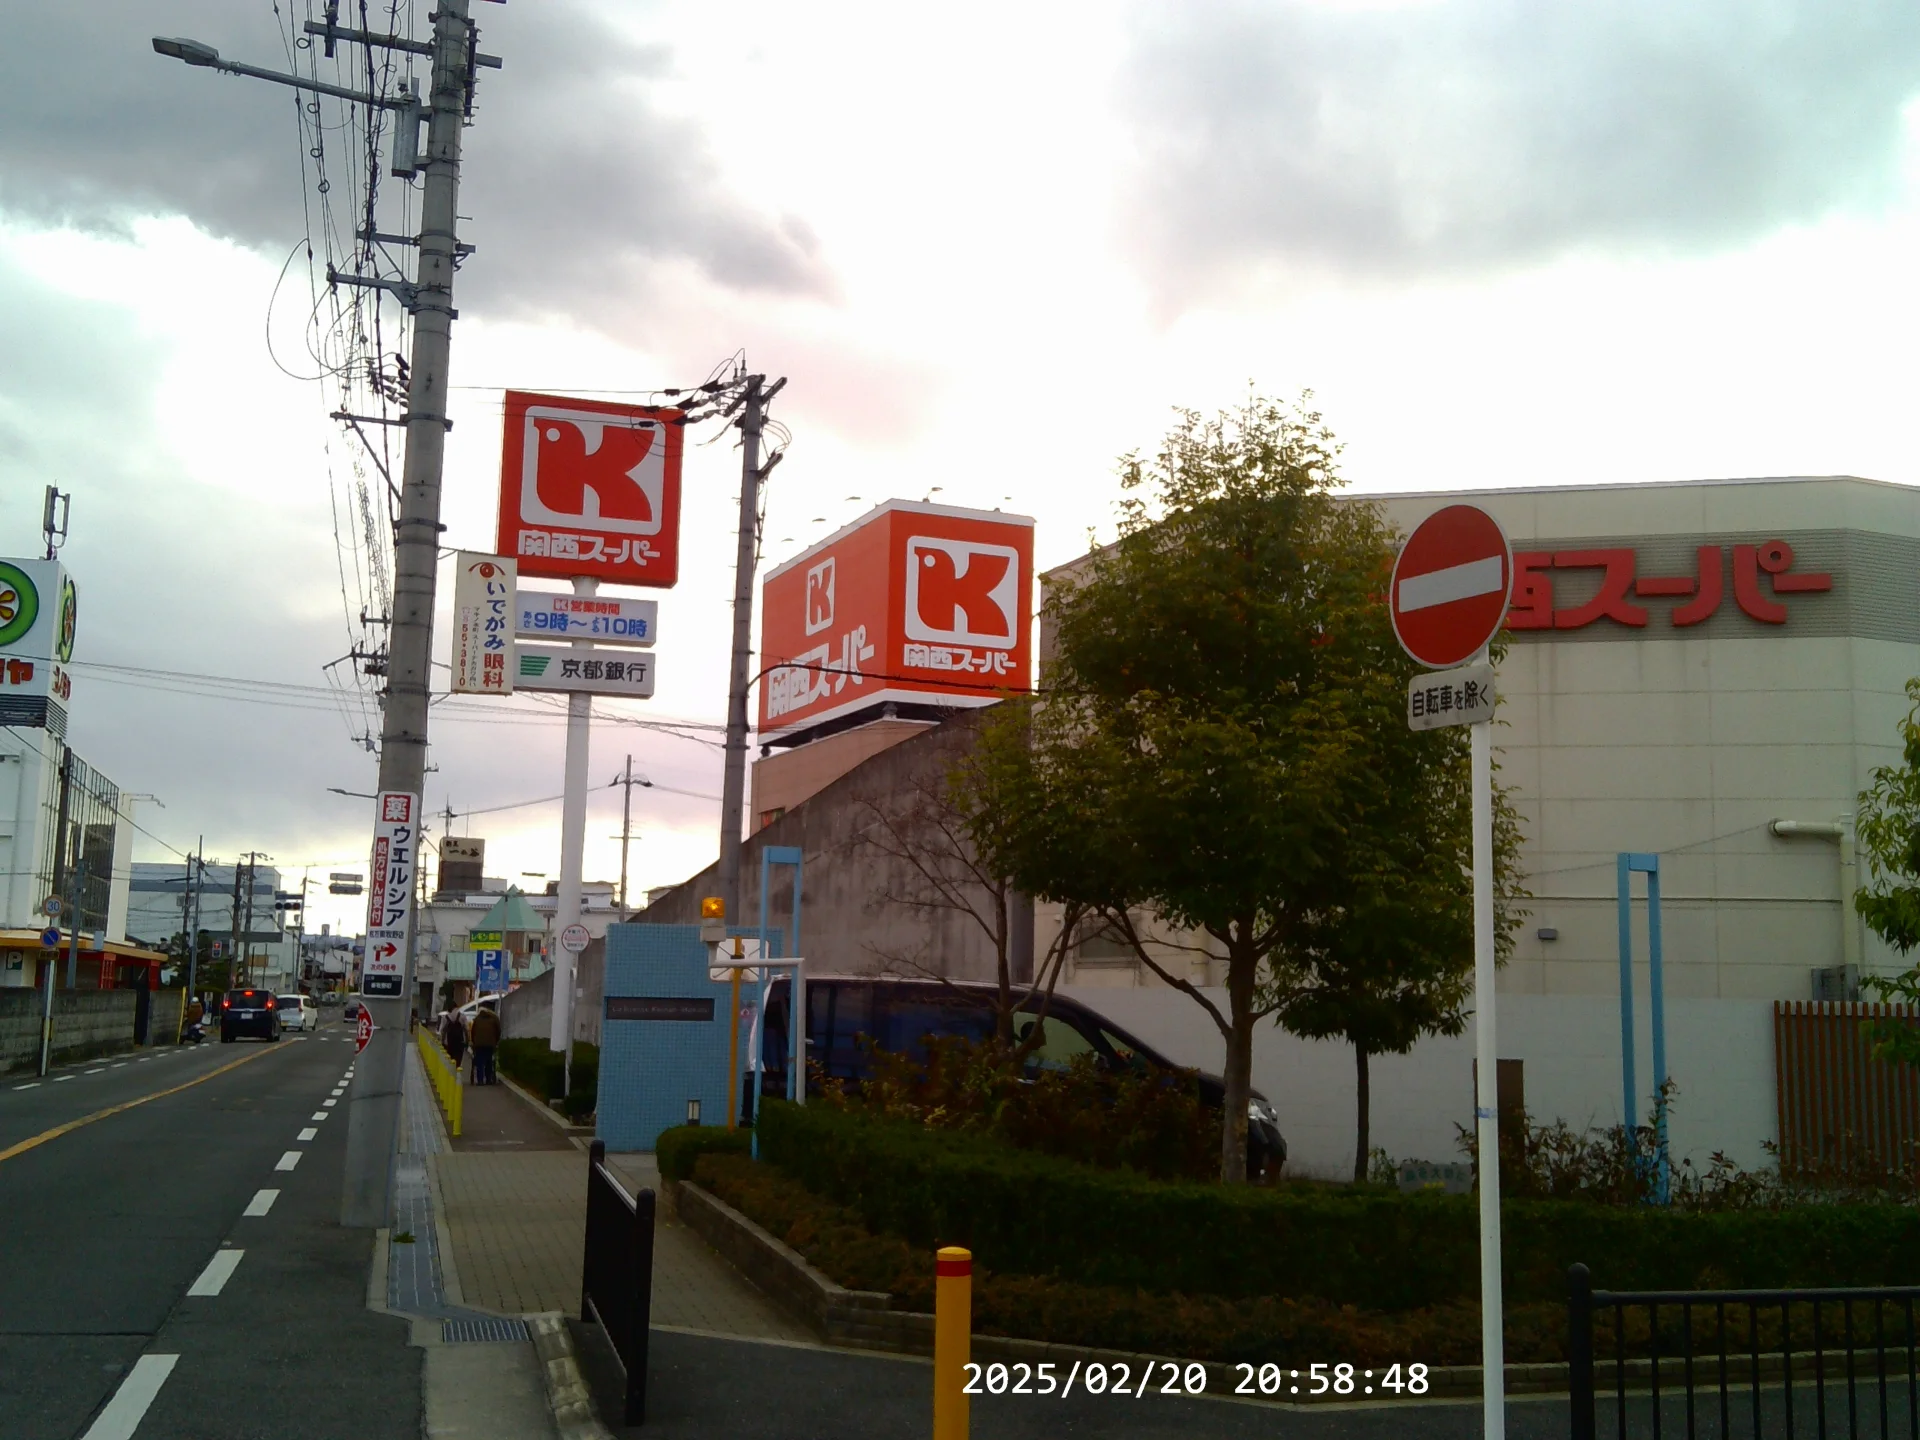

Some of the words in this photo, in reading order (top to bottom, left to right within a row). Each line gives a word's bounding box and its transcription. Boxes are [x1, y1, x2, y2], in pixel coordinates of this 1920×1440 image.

[517, 529, 661, 567] 関西スーパー
[571, 600, 621, 615] 営業時間
[560, 658, 648, 683] 京都銀行
[767, 624, 875, 720] 関西スーパー
[903, 643, 1017, 676] 関西スーパー
[1411, 680, 1490, 719] 自転車を除く
[385, 796, 409, 821] 薬
[370, 842, 390, 924] 処方せん受付
[386, 825, 411, 927] ウエルシア
[47, 901, 60, 912] 30
[8, 951, 22, 969] P
[482, 951, 497, 965] P
